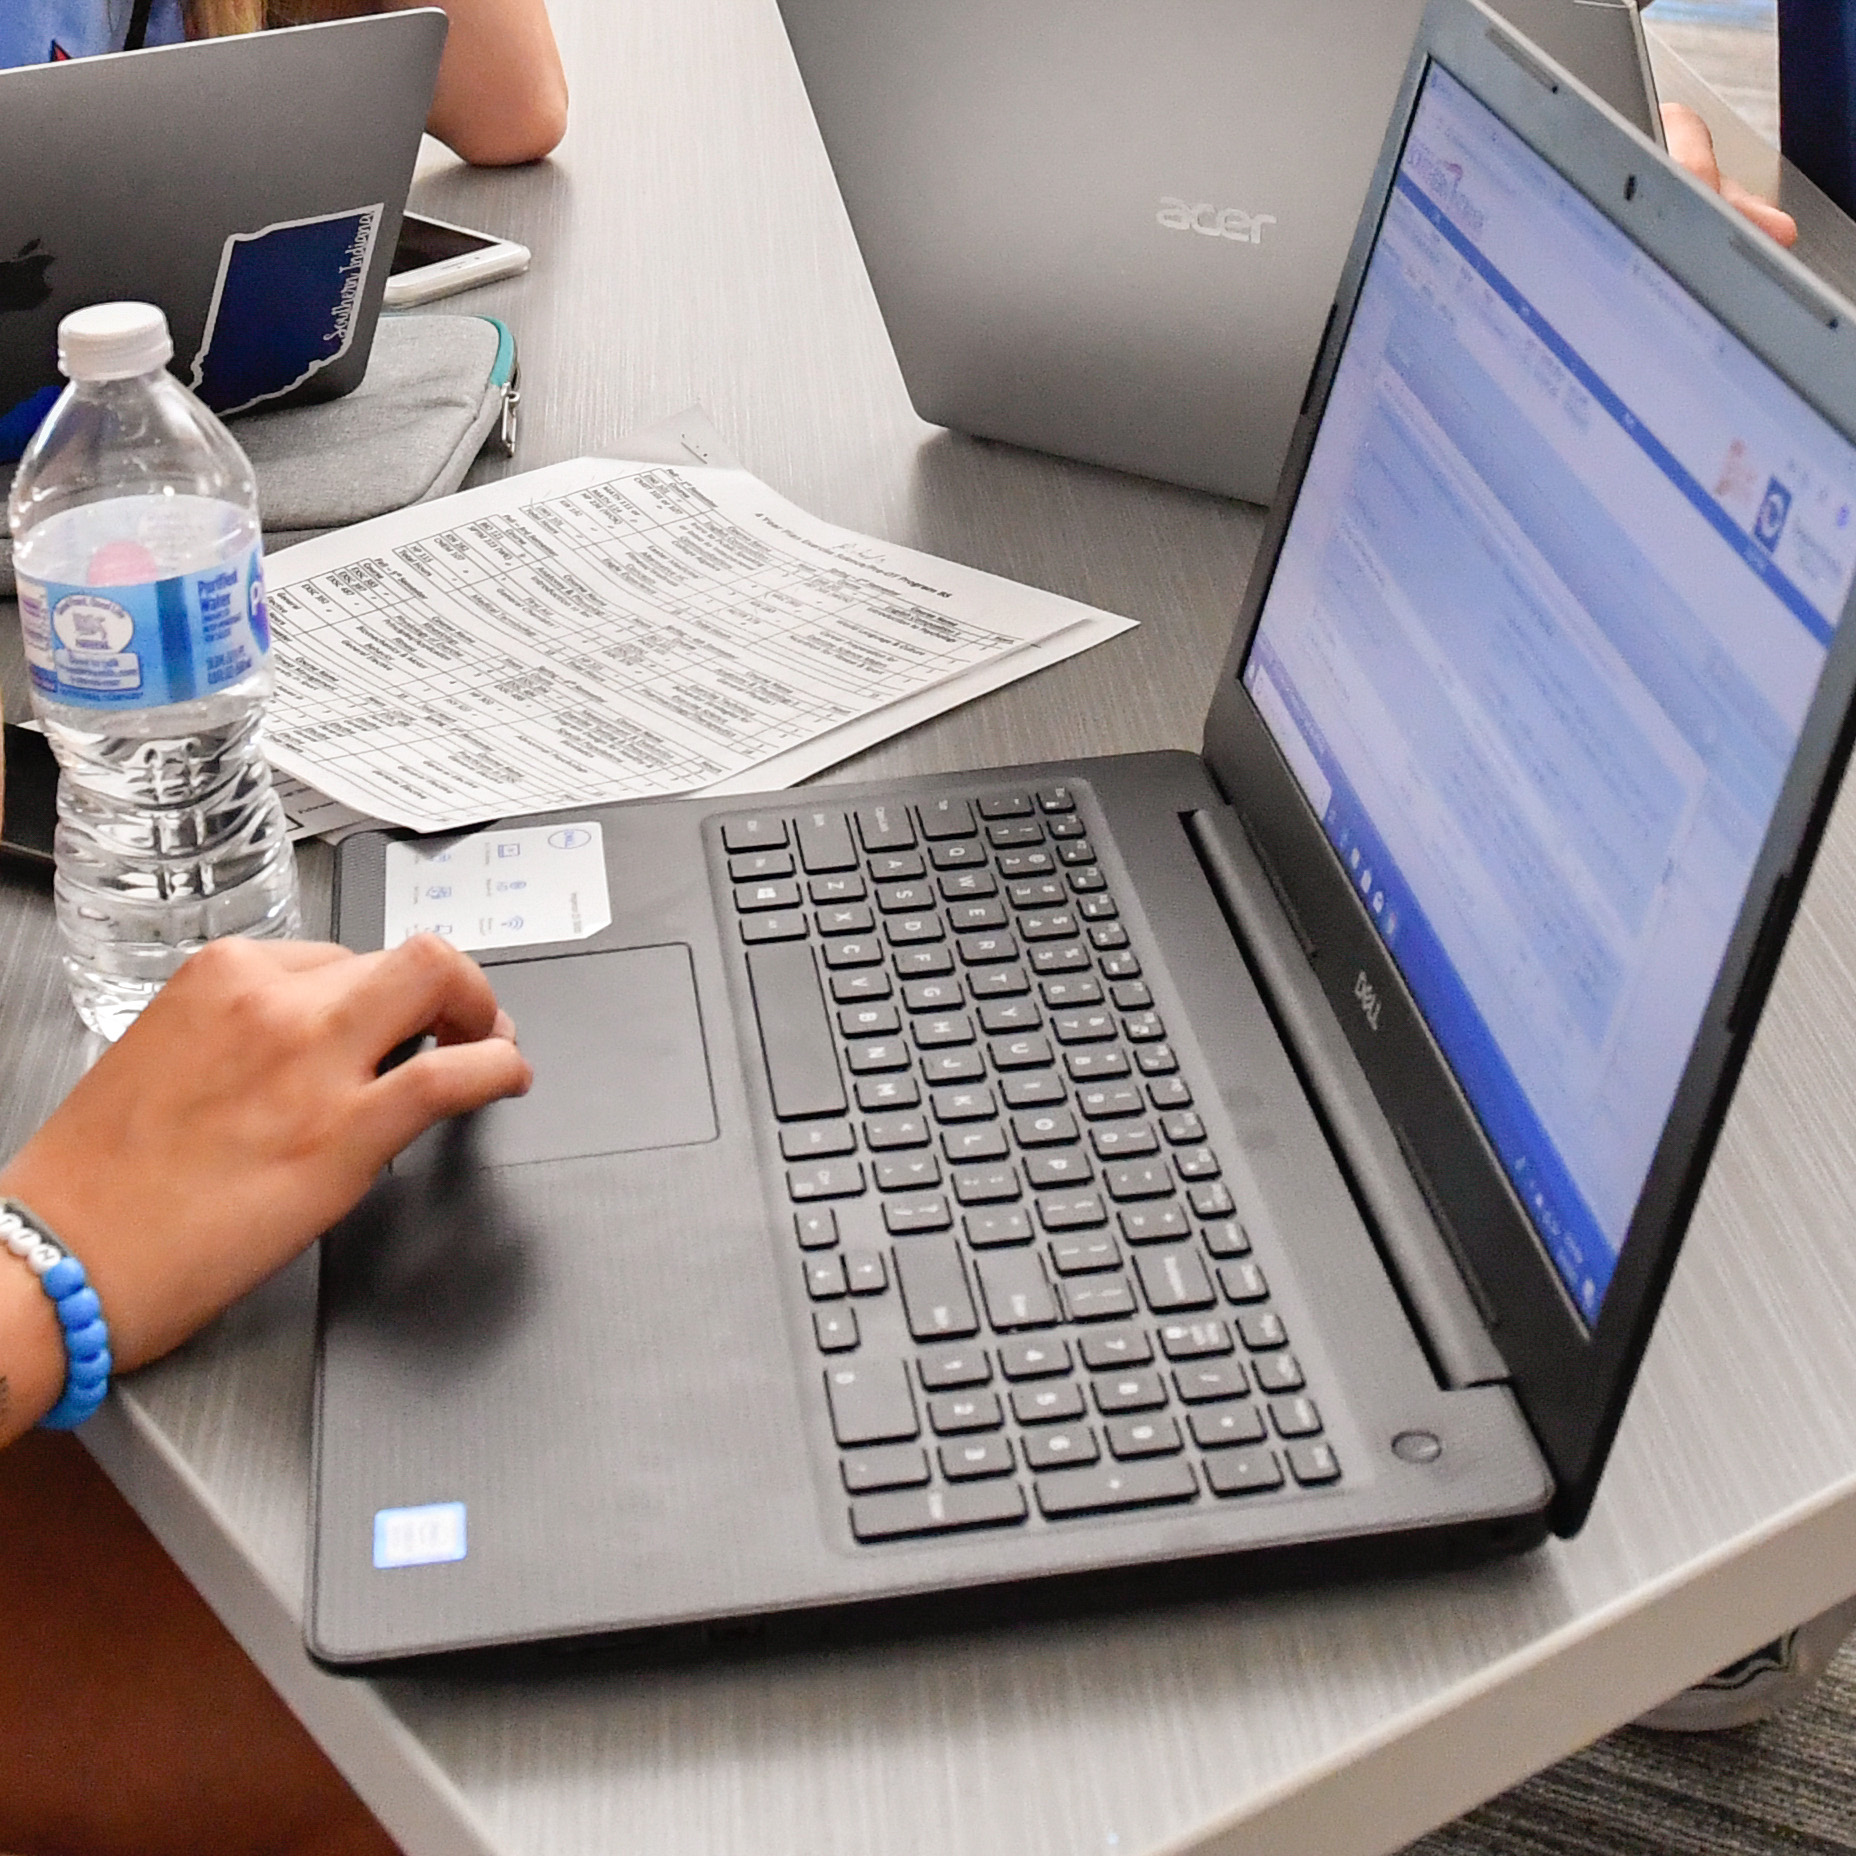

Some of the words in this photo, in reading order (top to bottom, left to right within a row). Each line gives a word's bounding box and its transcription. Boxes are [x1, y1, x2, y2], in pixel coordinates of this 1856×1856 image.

[338, 210, 374, 274] Indiana
[1156, 196, 1277, 244] acer
[322, 272, 361, 344] Southern
[1354, 971, 1382, 1030] DELL
